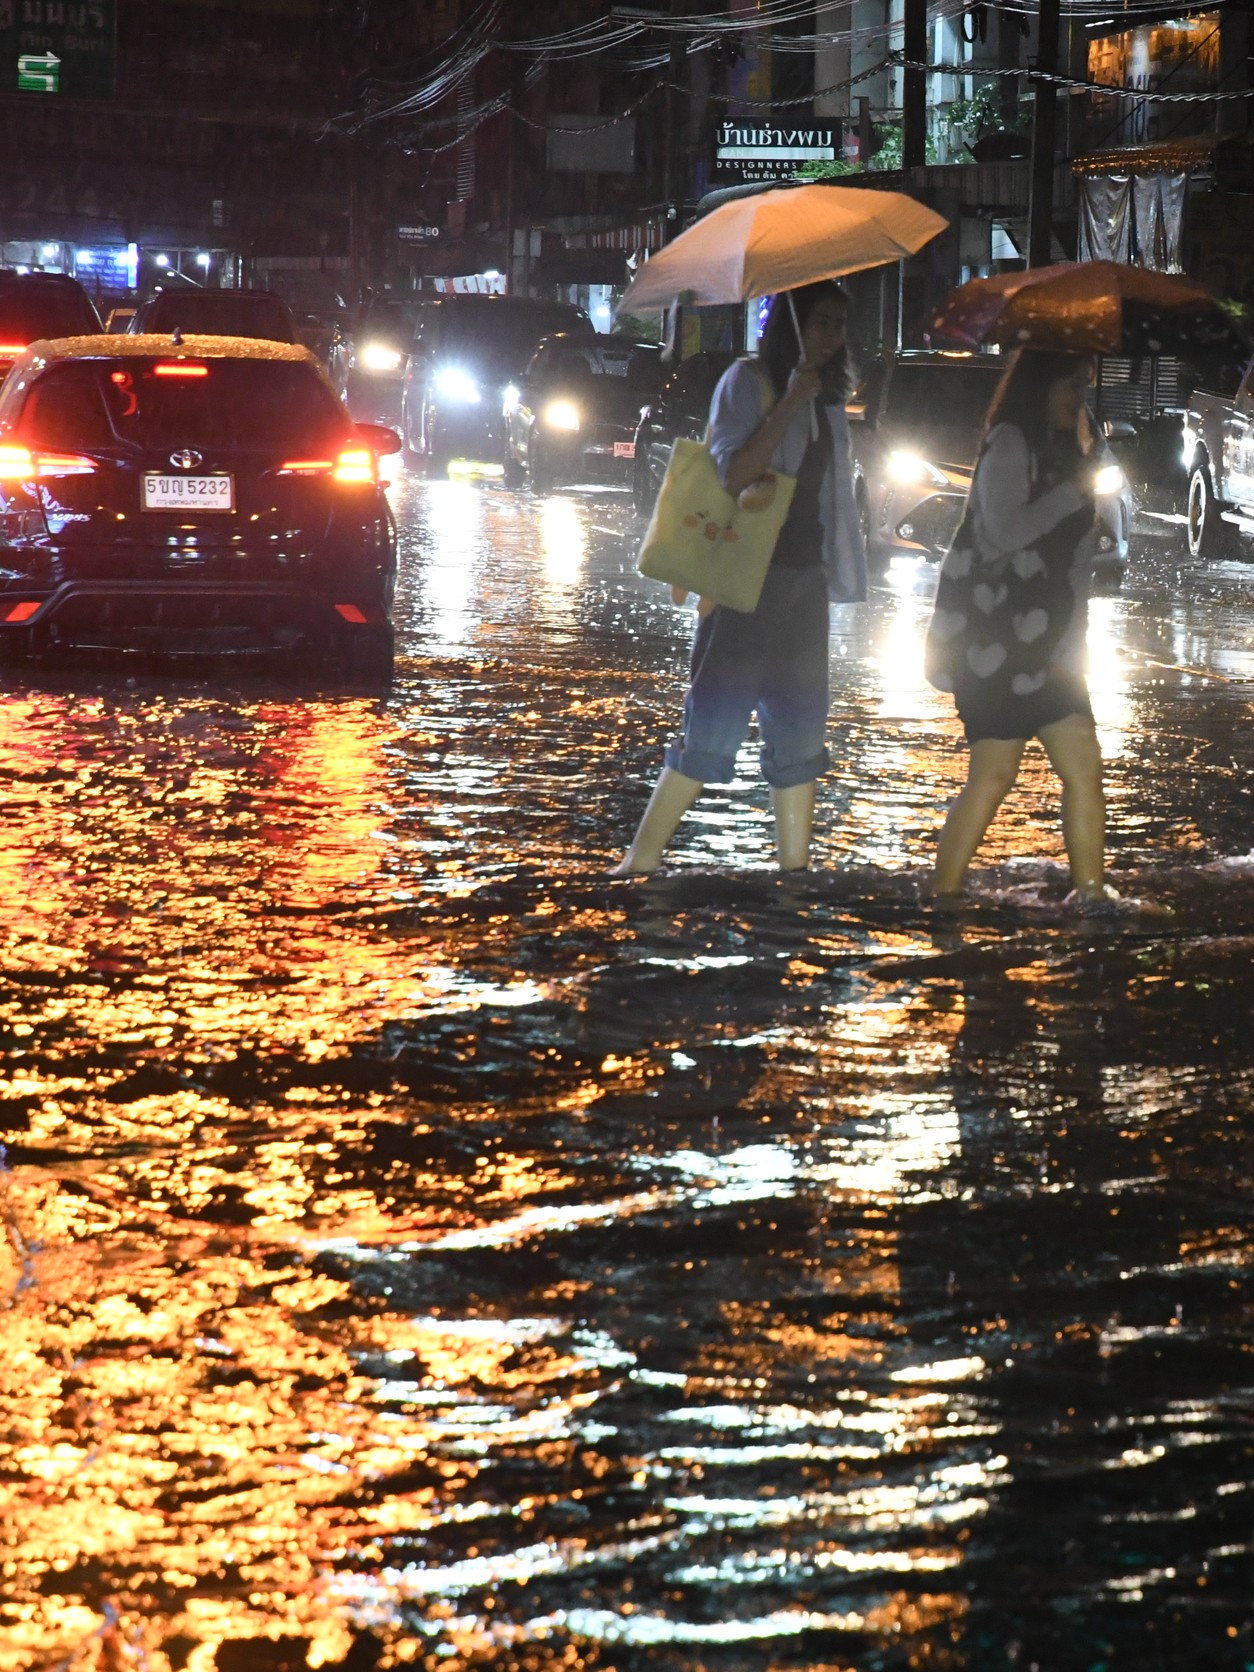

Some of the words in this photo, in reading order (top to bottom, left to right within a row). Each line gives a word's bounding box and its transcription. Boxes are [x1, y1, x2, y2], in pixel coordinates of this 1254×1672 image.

[716, 161, 797, 169] DESIGNNERS
[425, 227, 439, 237] 80
[147, 479, 184, 496] 5ขญ
[187, 480, 228, 495] 5232
